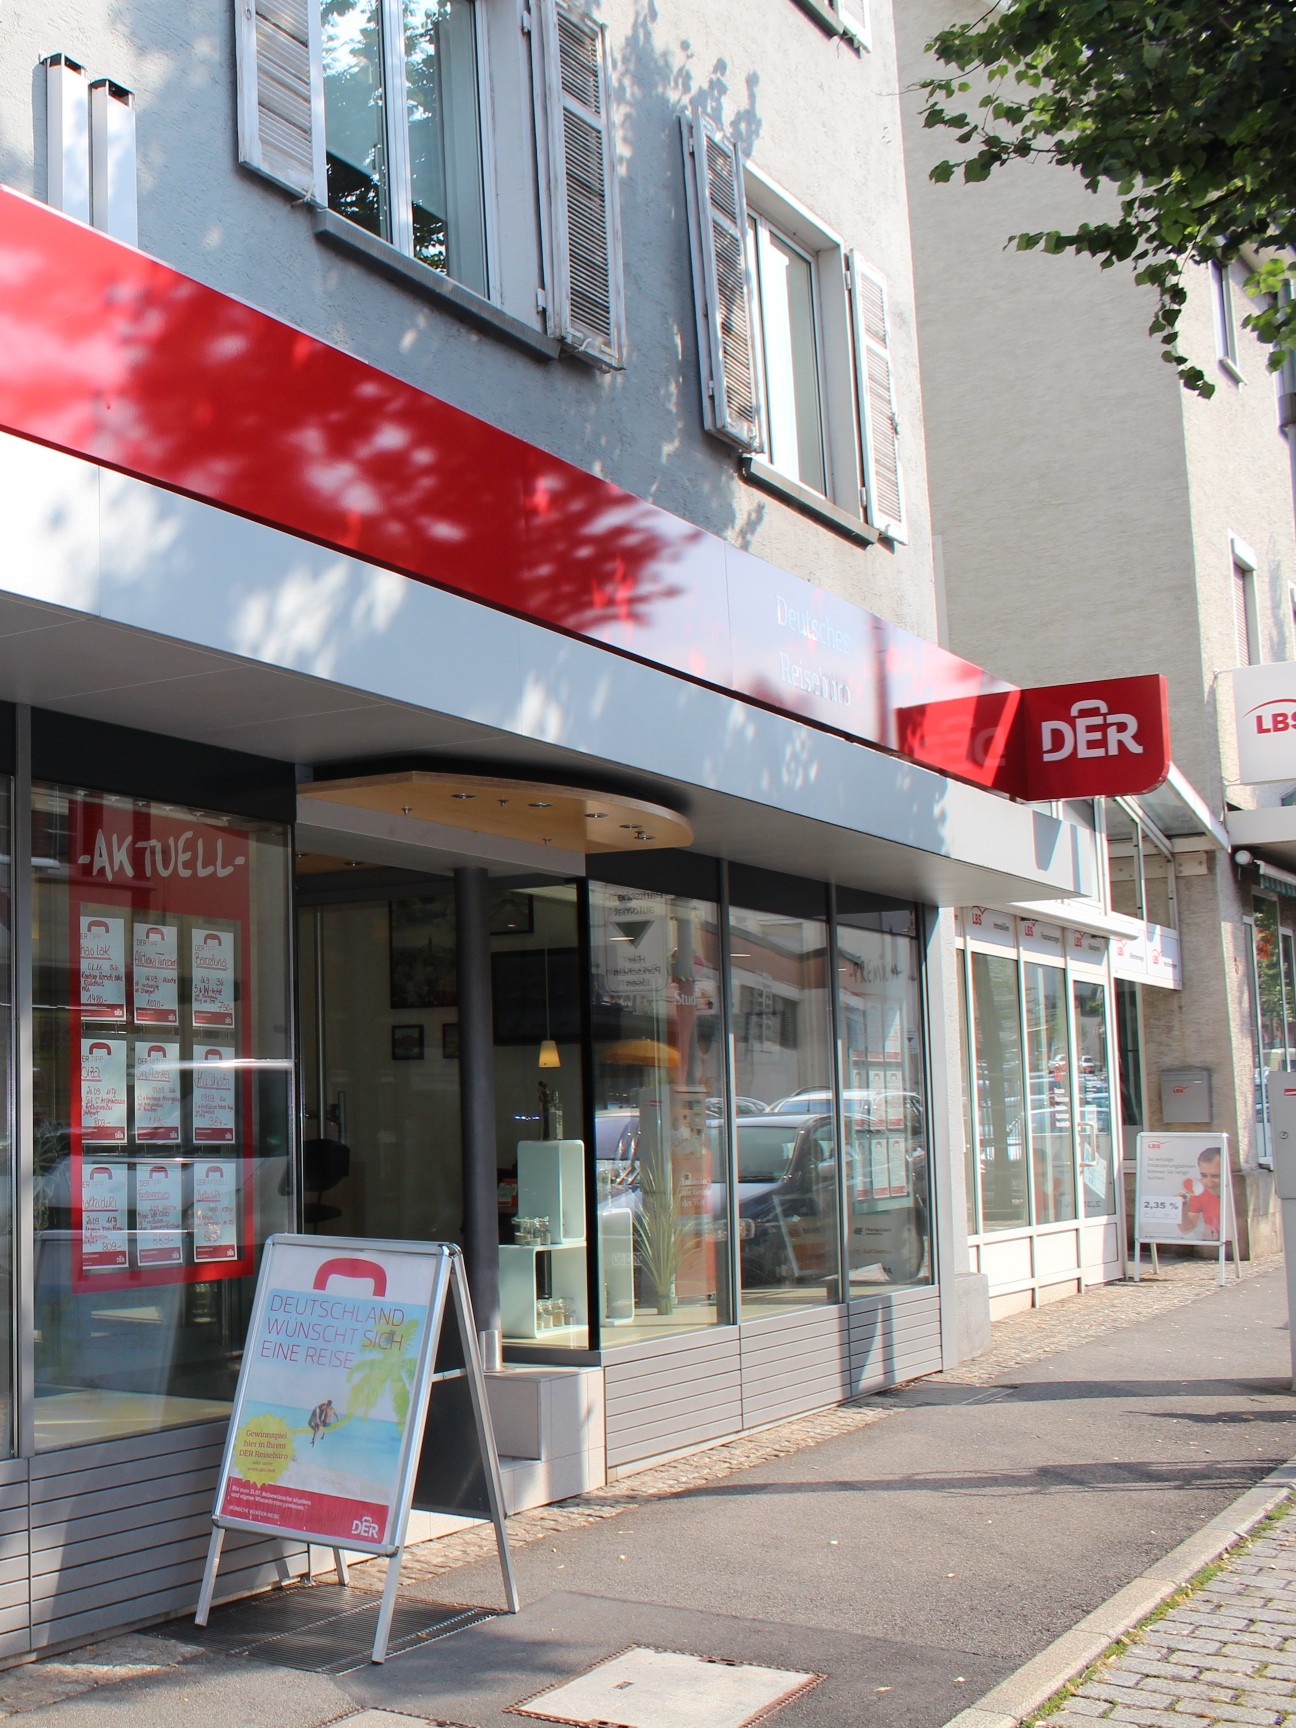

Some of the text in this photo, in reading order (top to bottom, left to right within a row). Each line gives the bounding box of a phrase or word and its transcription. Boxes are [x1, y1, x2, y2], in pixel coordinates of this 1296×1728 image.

[1041, 713, 1144, 762] DER
[1144, 1201, 1179, 1210] 2,35 %
[270, 1294, 405, 1327] DEUTSCHLAND
[267, 1317, 404, 1352] WÜNSCHT SICH
[260, 1340, 356, 1369] EINE REISE
[246, 1430, 288, 1440] Gewinnspiel
[352, 1520, 379, 1539] DER
